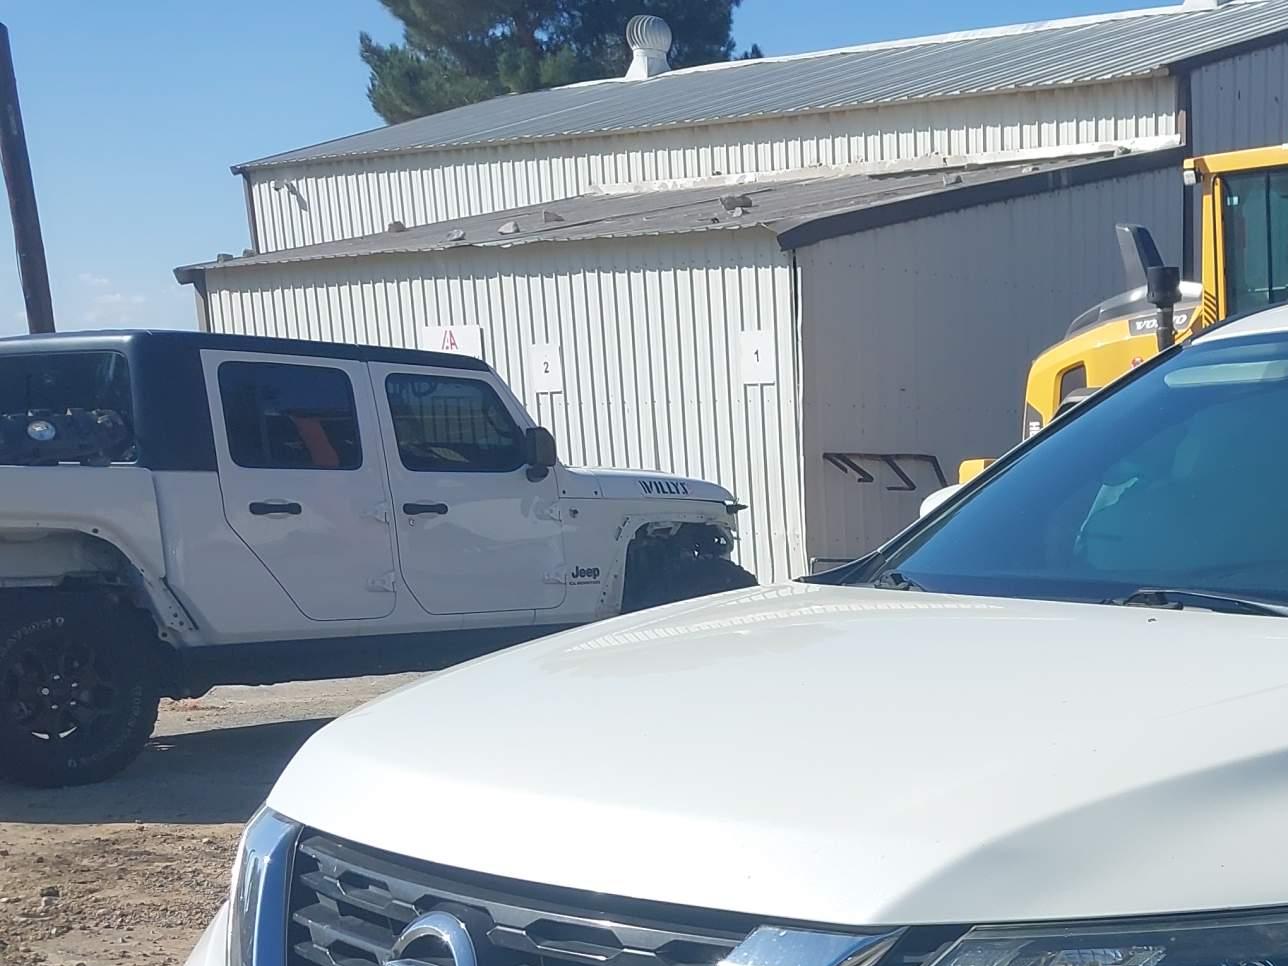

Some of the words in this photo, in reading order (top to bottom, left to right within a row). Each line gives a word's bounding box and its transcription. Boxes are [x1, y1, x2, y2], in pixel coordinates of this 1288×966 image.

[1135, 313, 1188, 331] VOVO
[753, 349, 760, 363] 1
[543, 361, 550, 374] 2
[638, 479, 689, 495] WILLYS
[571, 565, 600, 580] Jeep
